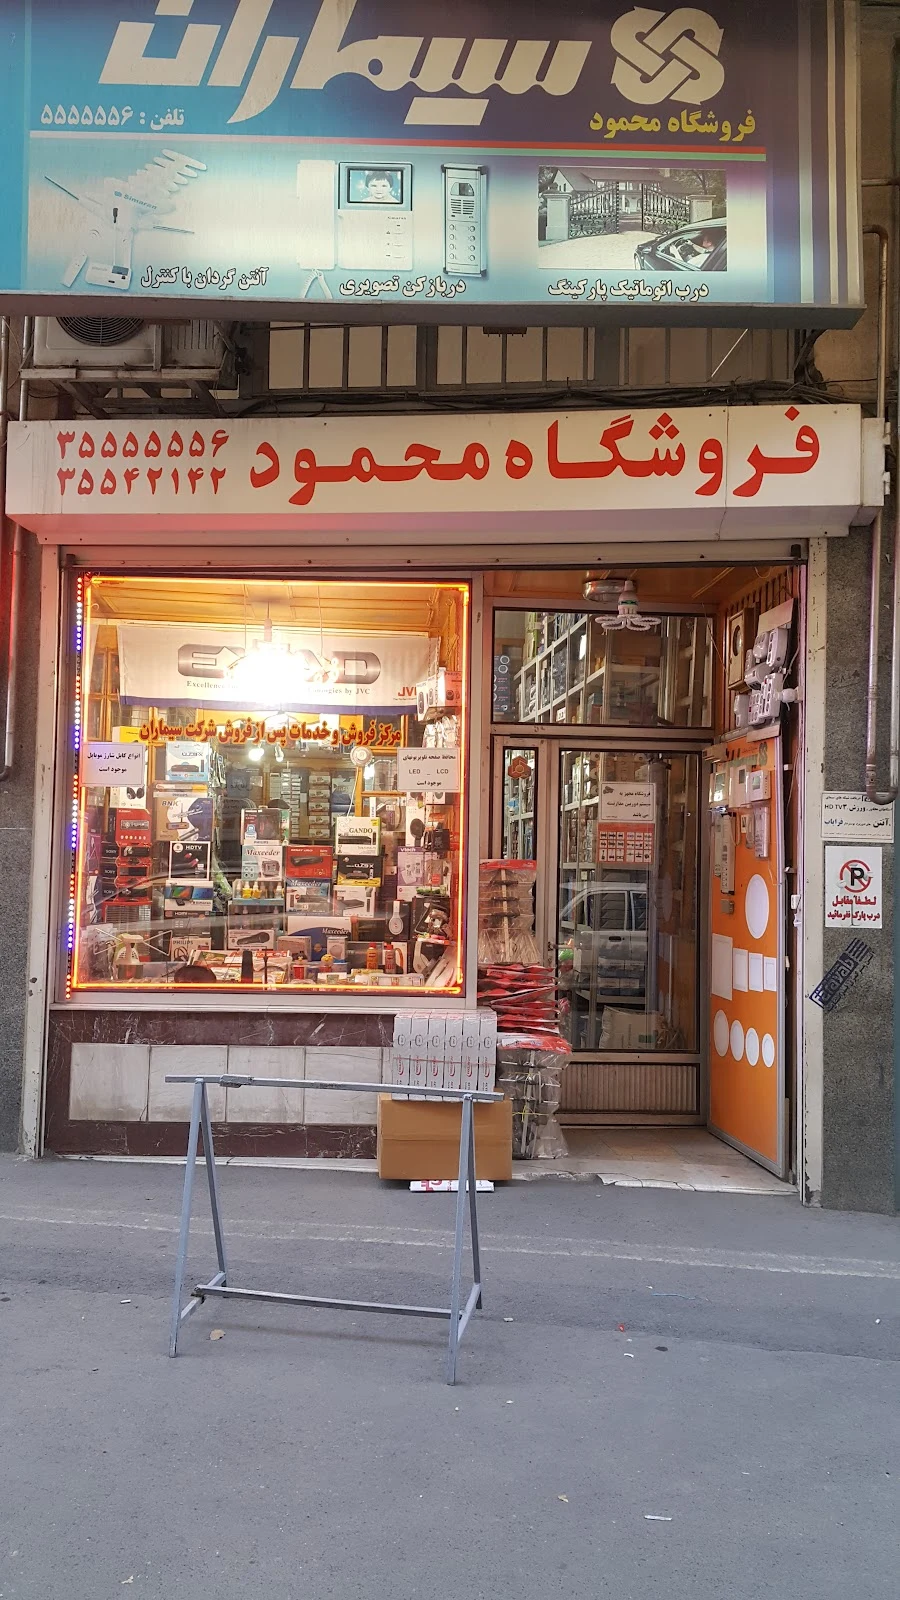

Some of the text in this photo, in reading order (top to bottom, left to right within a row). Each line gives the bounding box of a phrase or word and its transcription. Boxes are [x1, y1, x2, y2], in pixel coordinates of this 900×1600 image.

[40, 104, 133, 127] ۵۵۵۵۵۵۶
[589, 109, 756, 142] فروشگاه محمود
[141, 265, 269, 290] آنتن گردان با کنترل
[339, 275, 400, 297] تصویری
[548, 279, 709, 301] درب اتوماتیک پارکینگ
[56, 429, 230, 460] ۳۵۵۵۵۵۵۶
[250, 405, 820, 506] فروشگاه محمود
[56, 467, 227, 496] ۳۵۵۴۲۱۴۲
[397, 686, 417, 697] JV
[140, 717, 401, 746] مرکز فروش و خدمات پس از فروش شرکت سیماران
[873, 817, 889, 828] آنتن
[246, 849, 280, 857] Maxeeder
[290, 879, 321, 887] Maxeeder
[832, 894, 853, 907] مقابل
[851, 910, 866, 922] پارک
[866, 912, 881, 922] درب
[322, 927, 349, 935] Maxeeder
